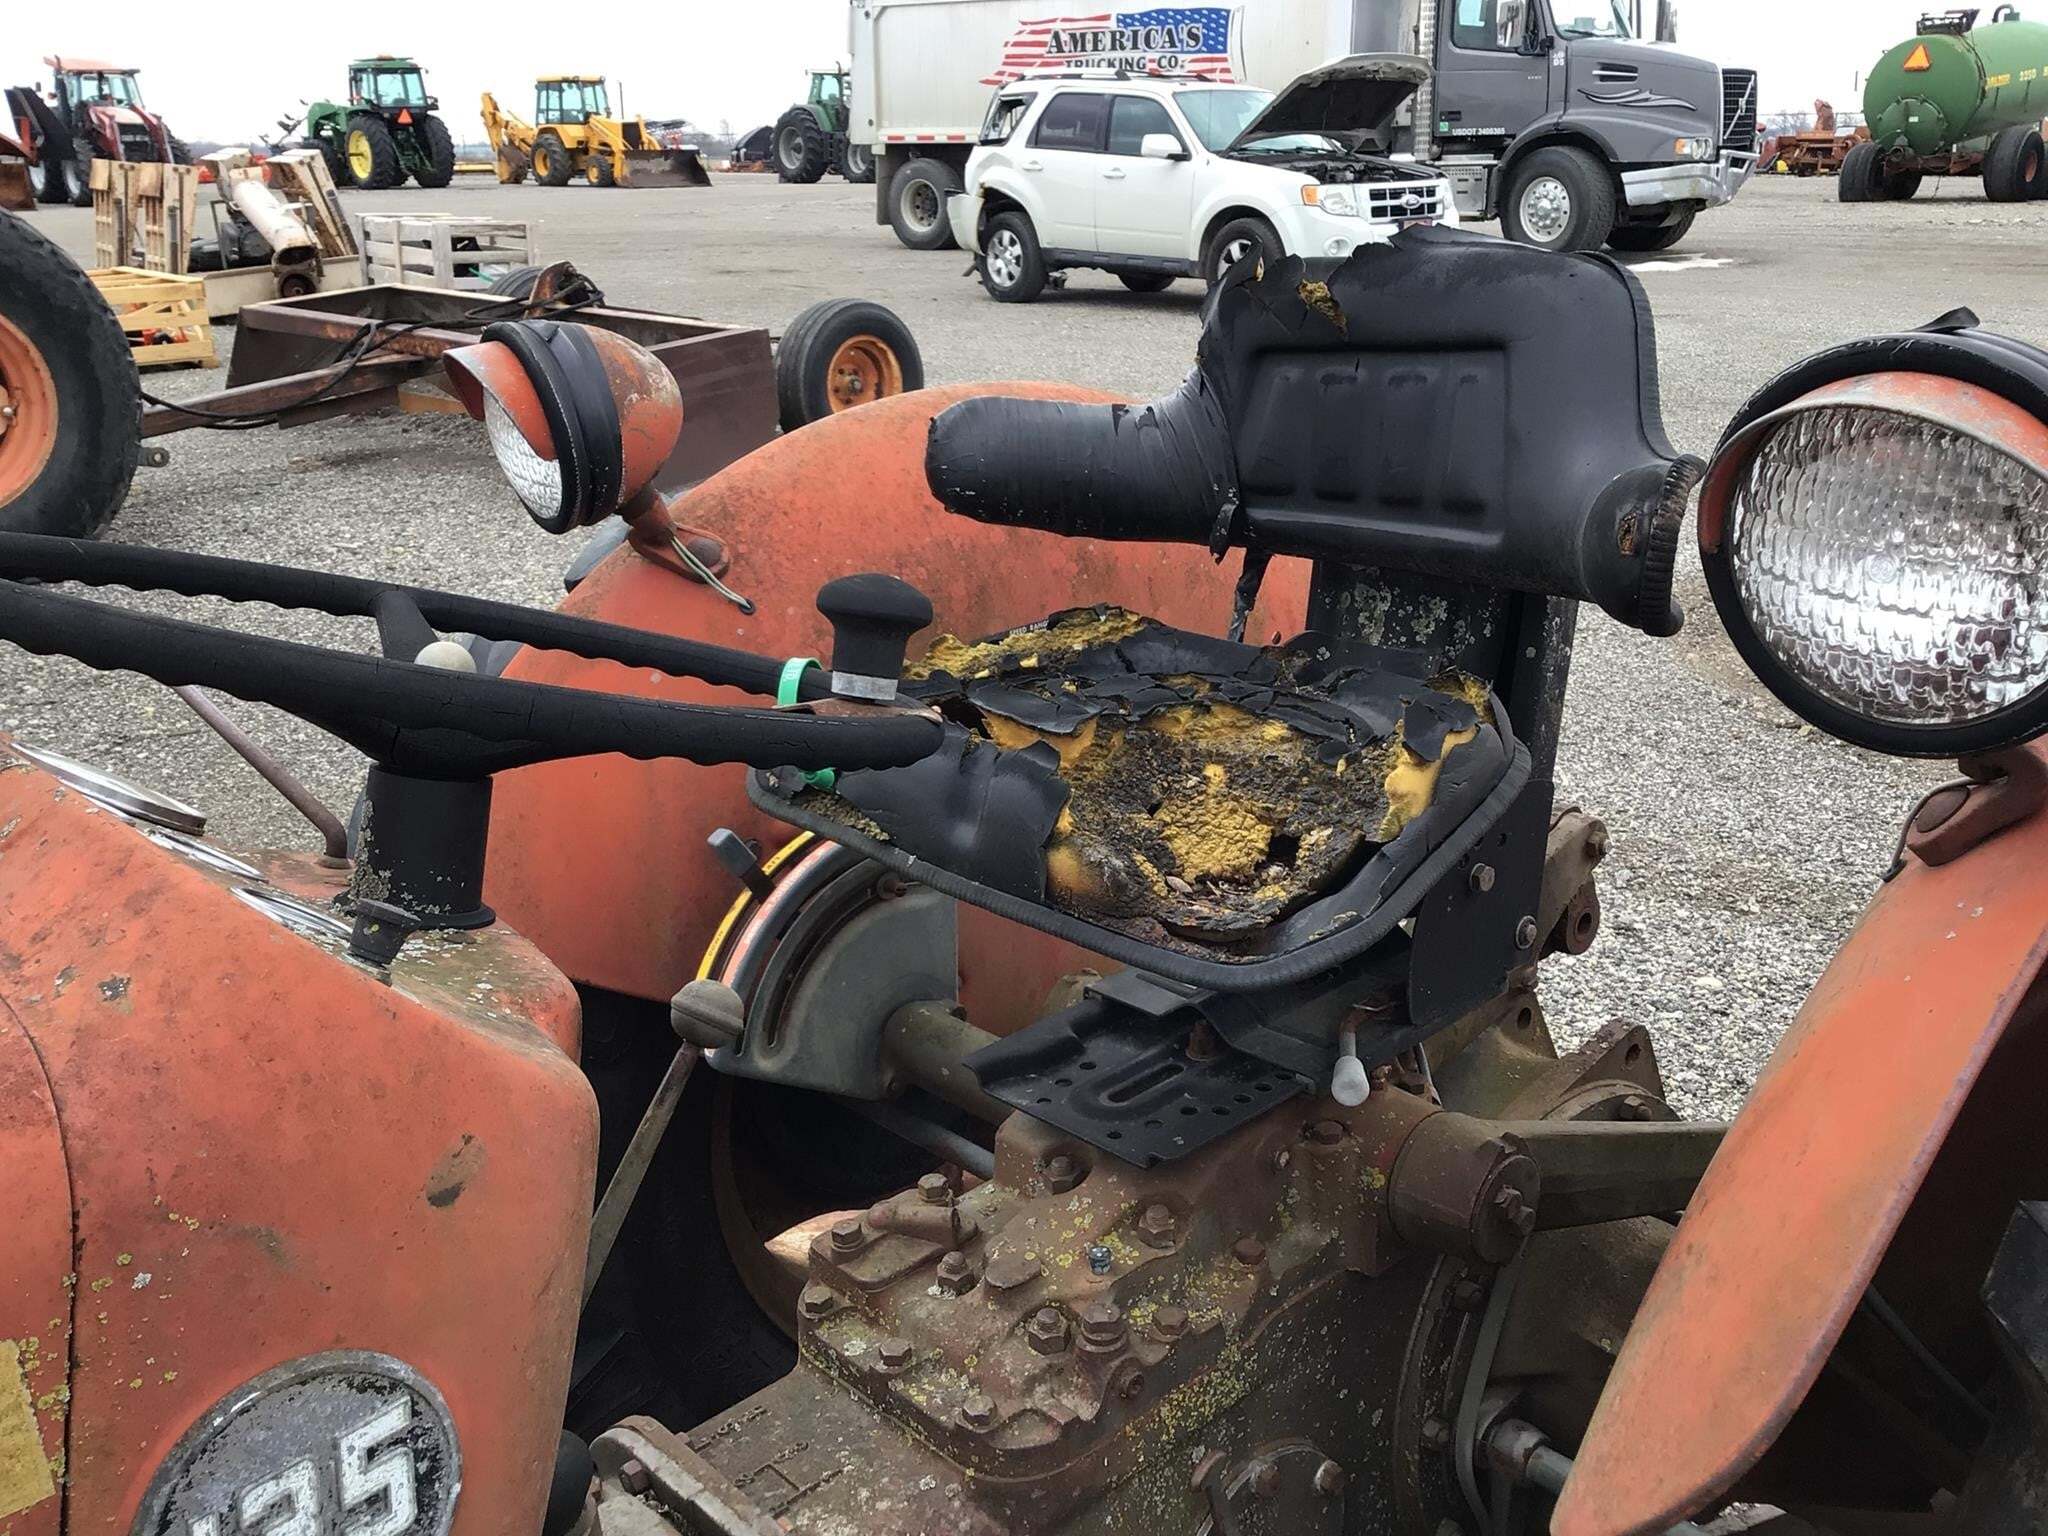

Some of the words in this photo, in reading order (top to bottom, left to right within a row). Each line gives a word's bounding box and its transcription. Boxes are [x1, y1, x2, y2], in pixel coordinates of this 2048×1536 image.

[1046, 24, 1202, 54] AMERICA'S
[1065, 56, 1147, 70] TRUCKING
[1452, 127, 1477, 136] USDOT
